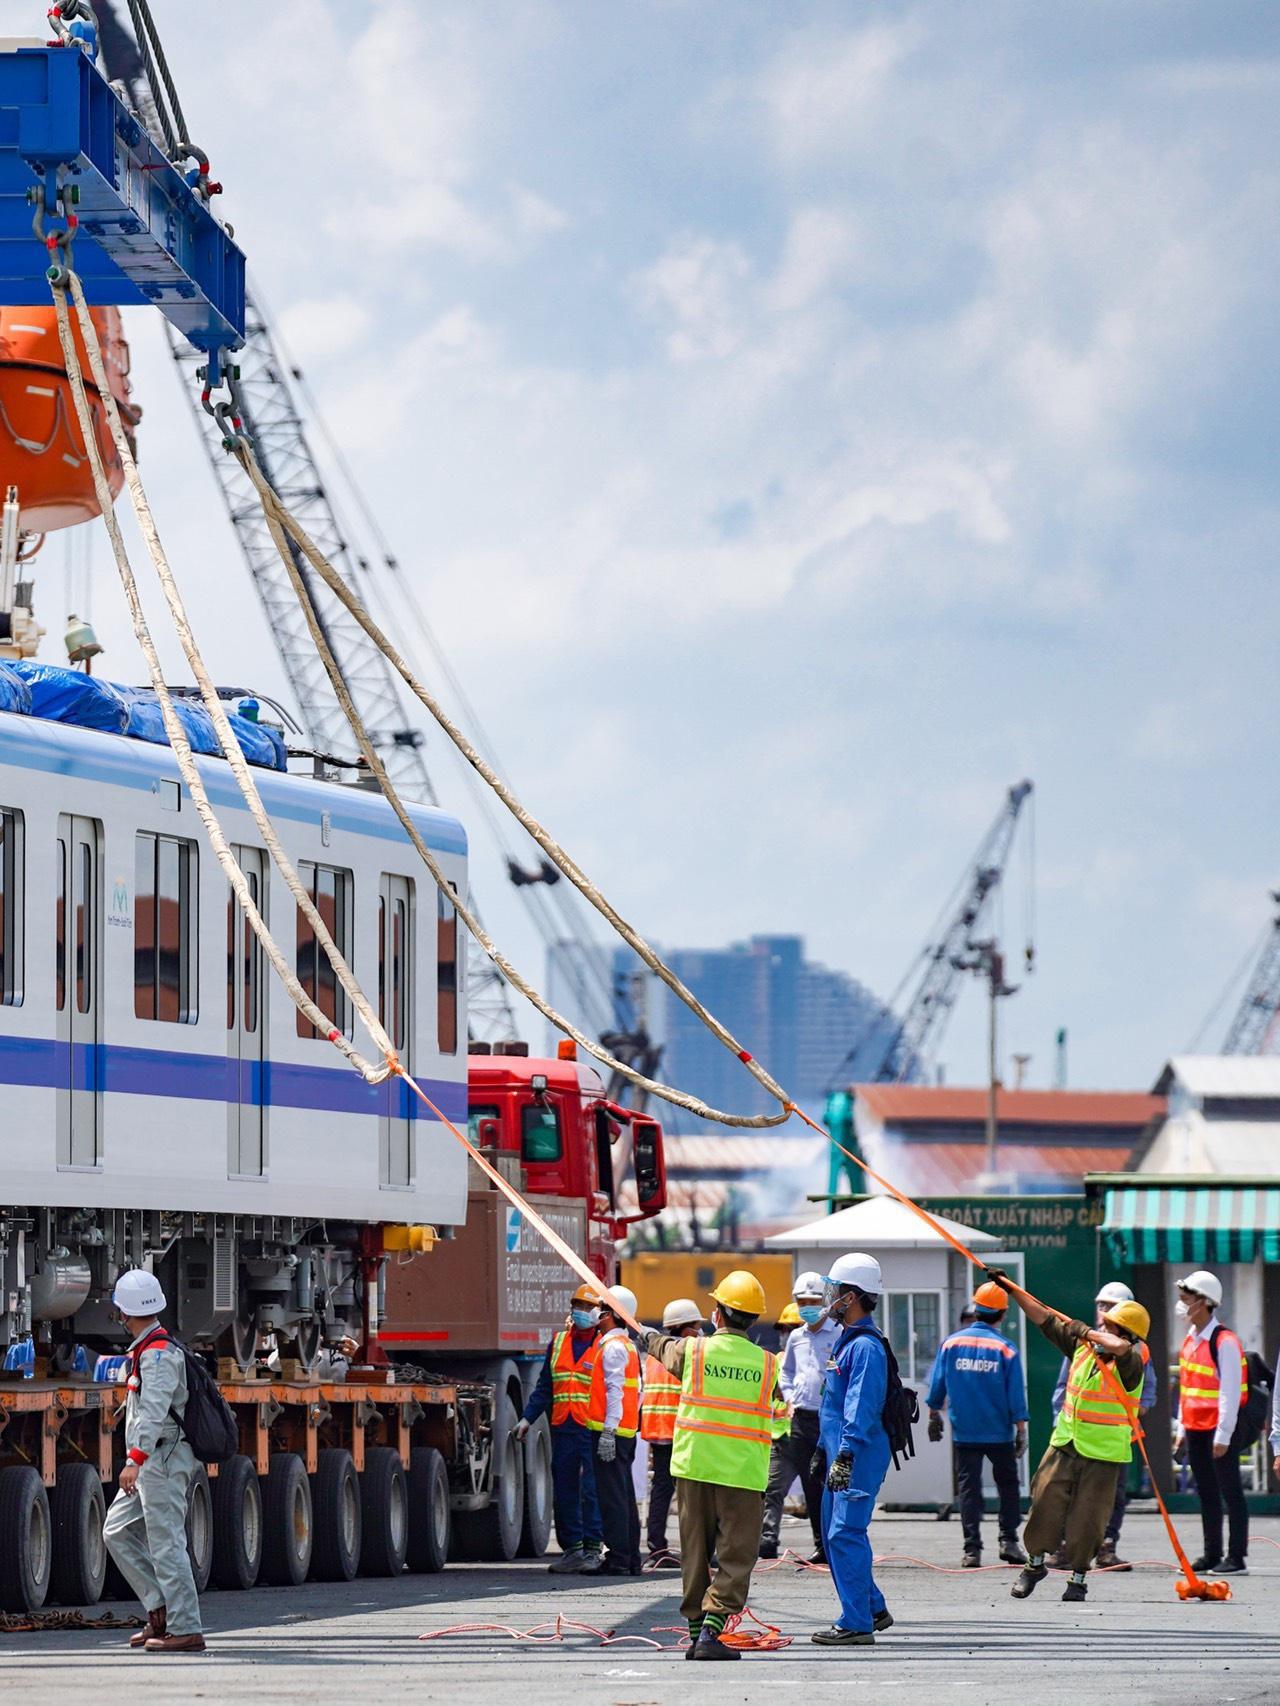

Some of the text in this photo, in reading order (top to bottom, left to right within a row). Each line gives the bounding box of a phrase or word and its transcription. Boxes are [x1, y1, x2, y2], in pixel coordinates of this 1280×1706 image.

[987, 1202, 1028, 1226] XUẤT
[1031, 1205, 1073, 1230] NHẬP
[704, 1363, 762, 1384] SASTECO
